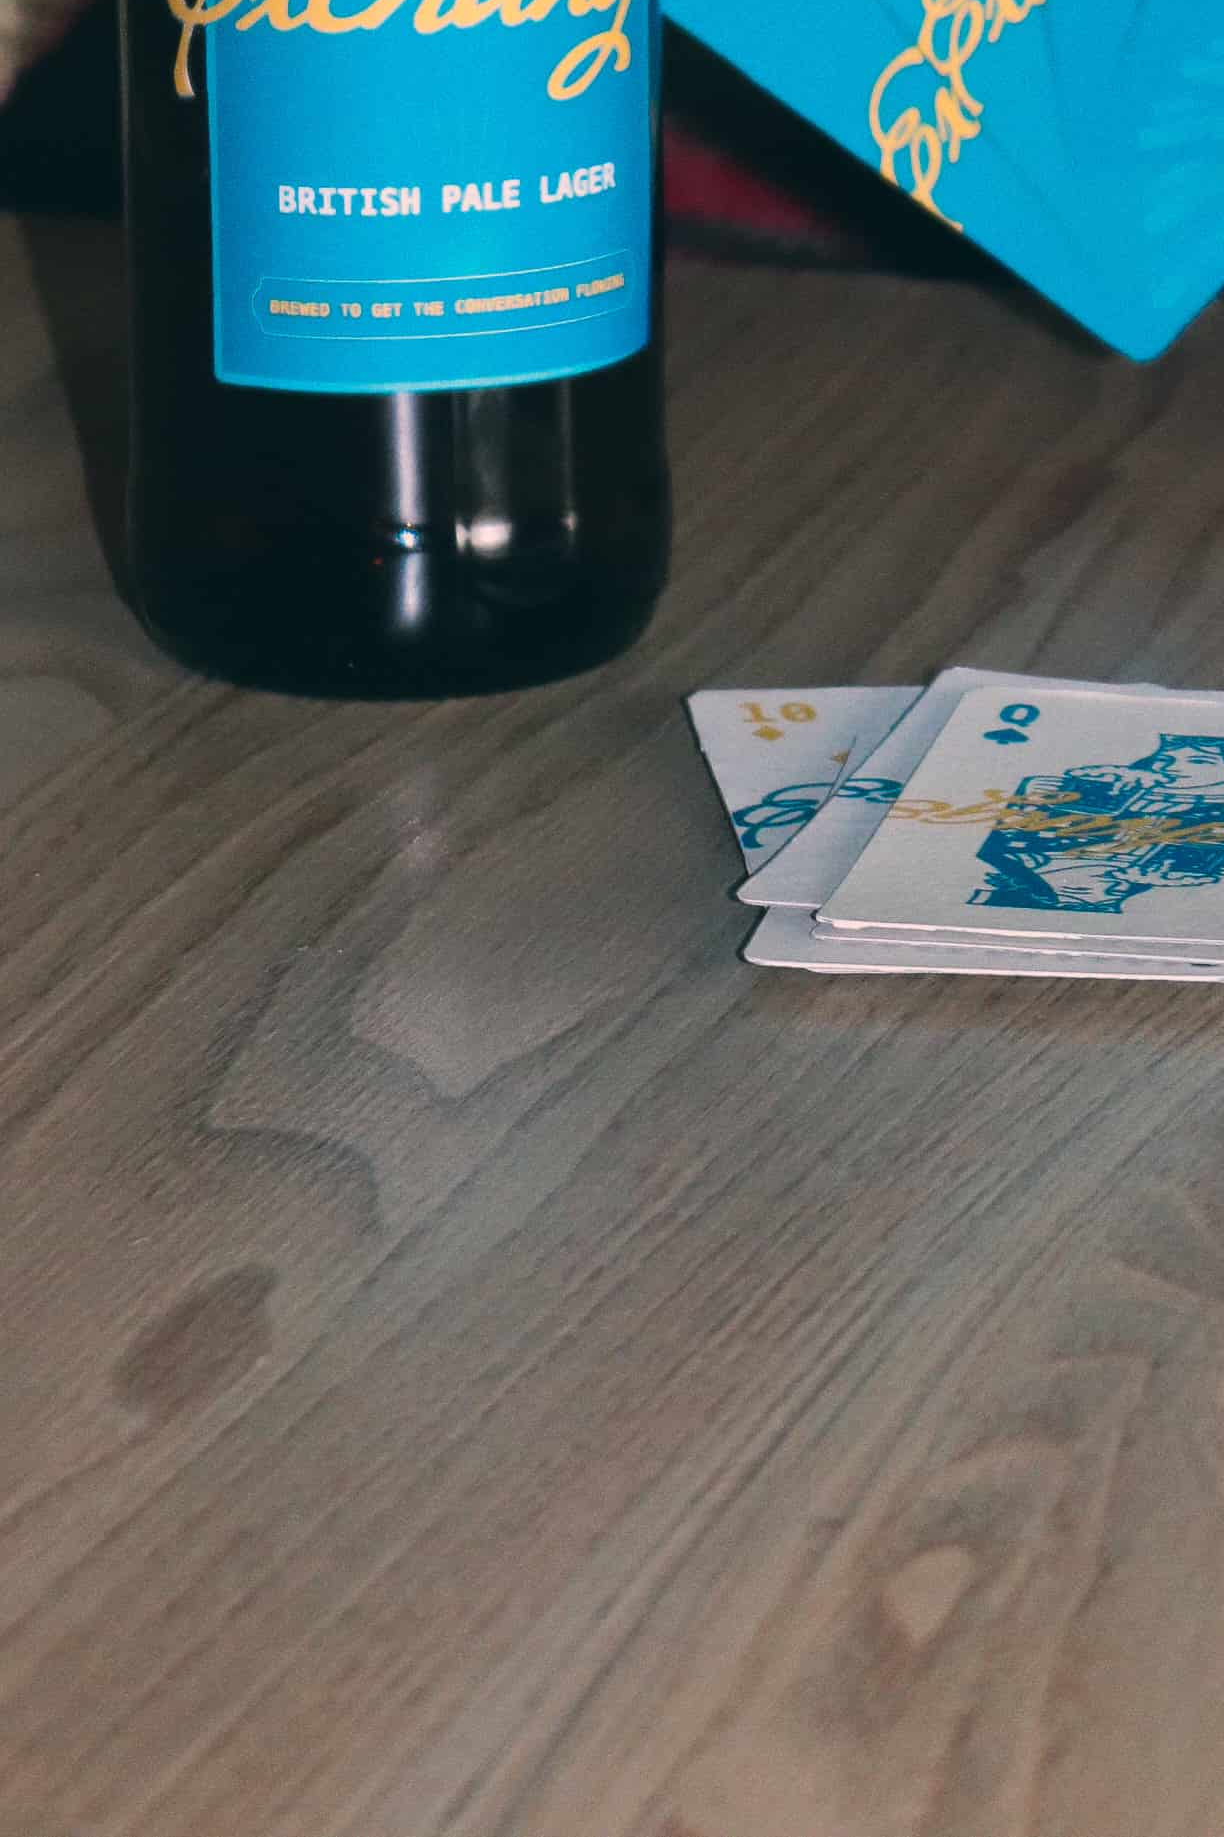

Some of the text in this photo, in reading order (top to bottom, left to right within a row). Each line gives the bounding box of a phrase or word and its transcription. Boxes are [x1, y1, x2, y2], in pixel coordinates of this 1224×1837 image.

[278, 162, 617, 218] BRITISH PALE LAGER
[269, 299, 330, 318] BREWED
[340, 303, 362, 318] TO
[371, 302, 402, 319] GET
[413, 301, 444, 318] THE
[454, 287, 570, 315] CONVERSATION
[739, 701, 818, 724] 10
[999, 703, 1041, 728] Q
